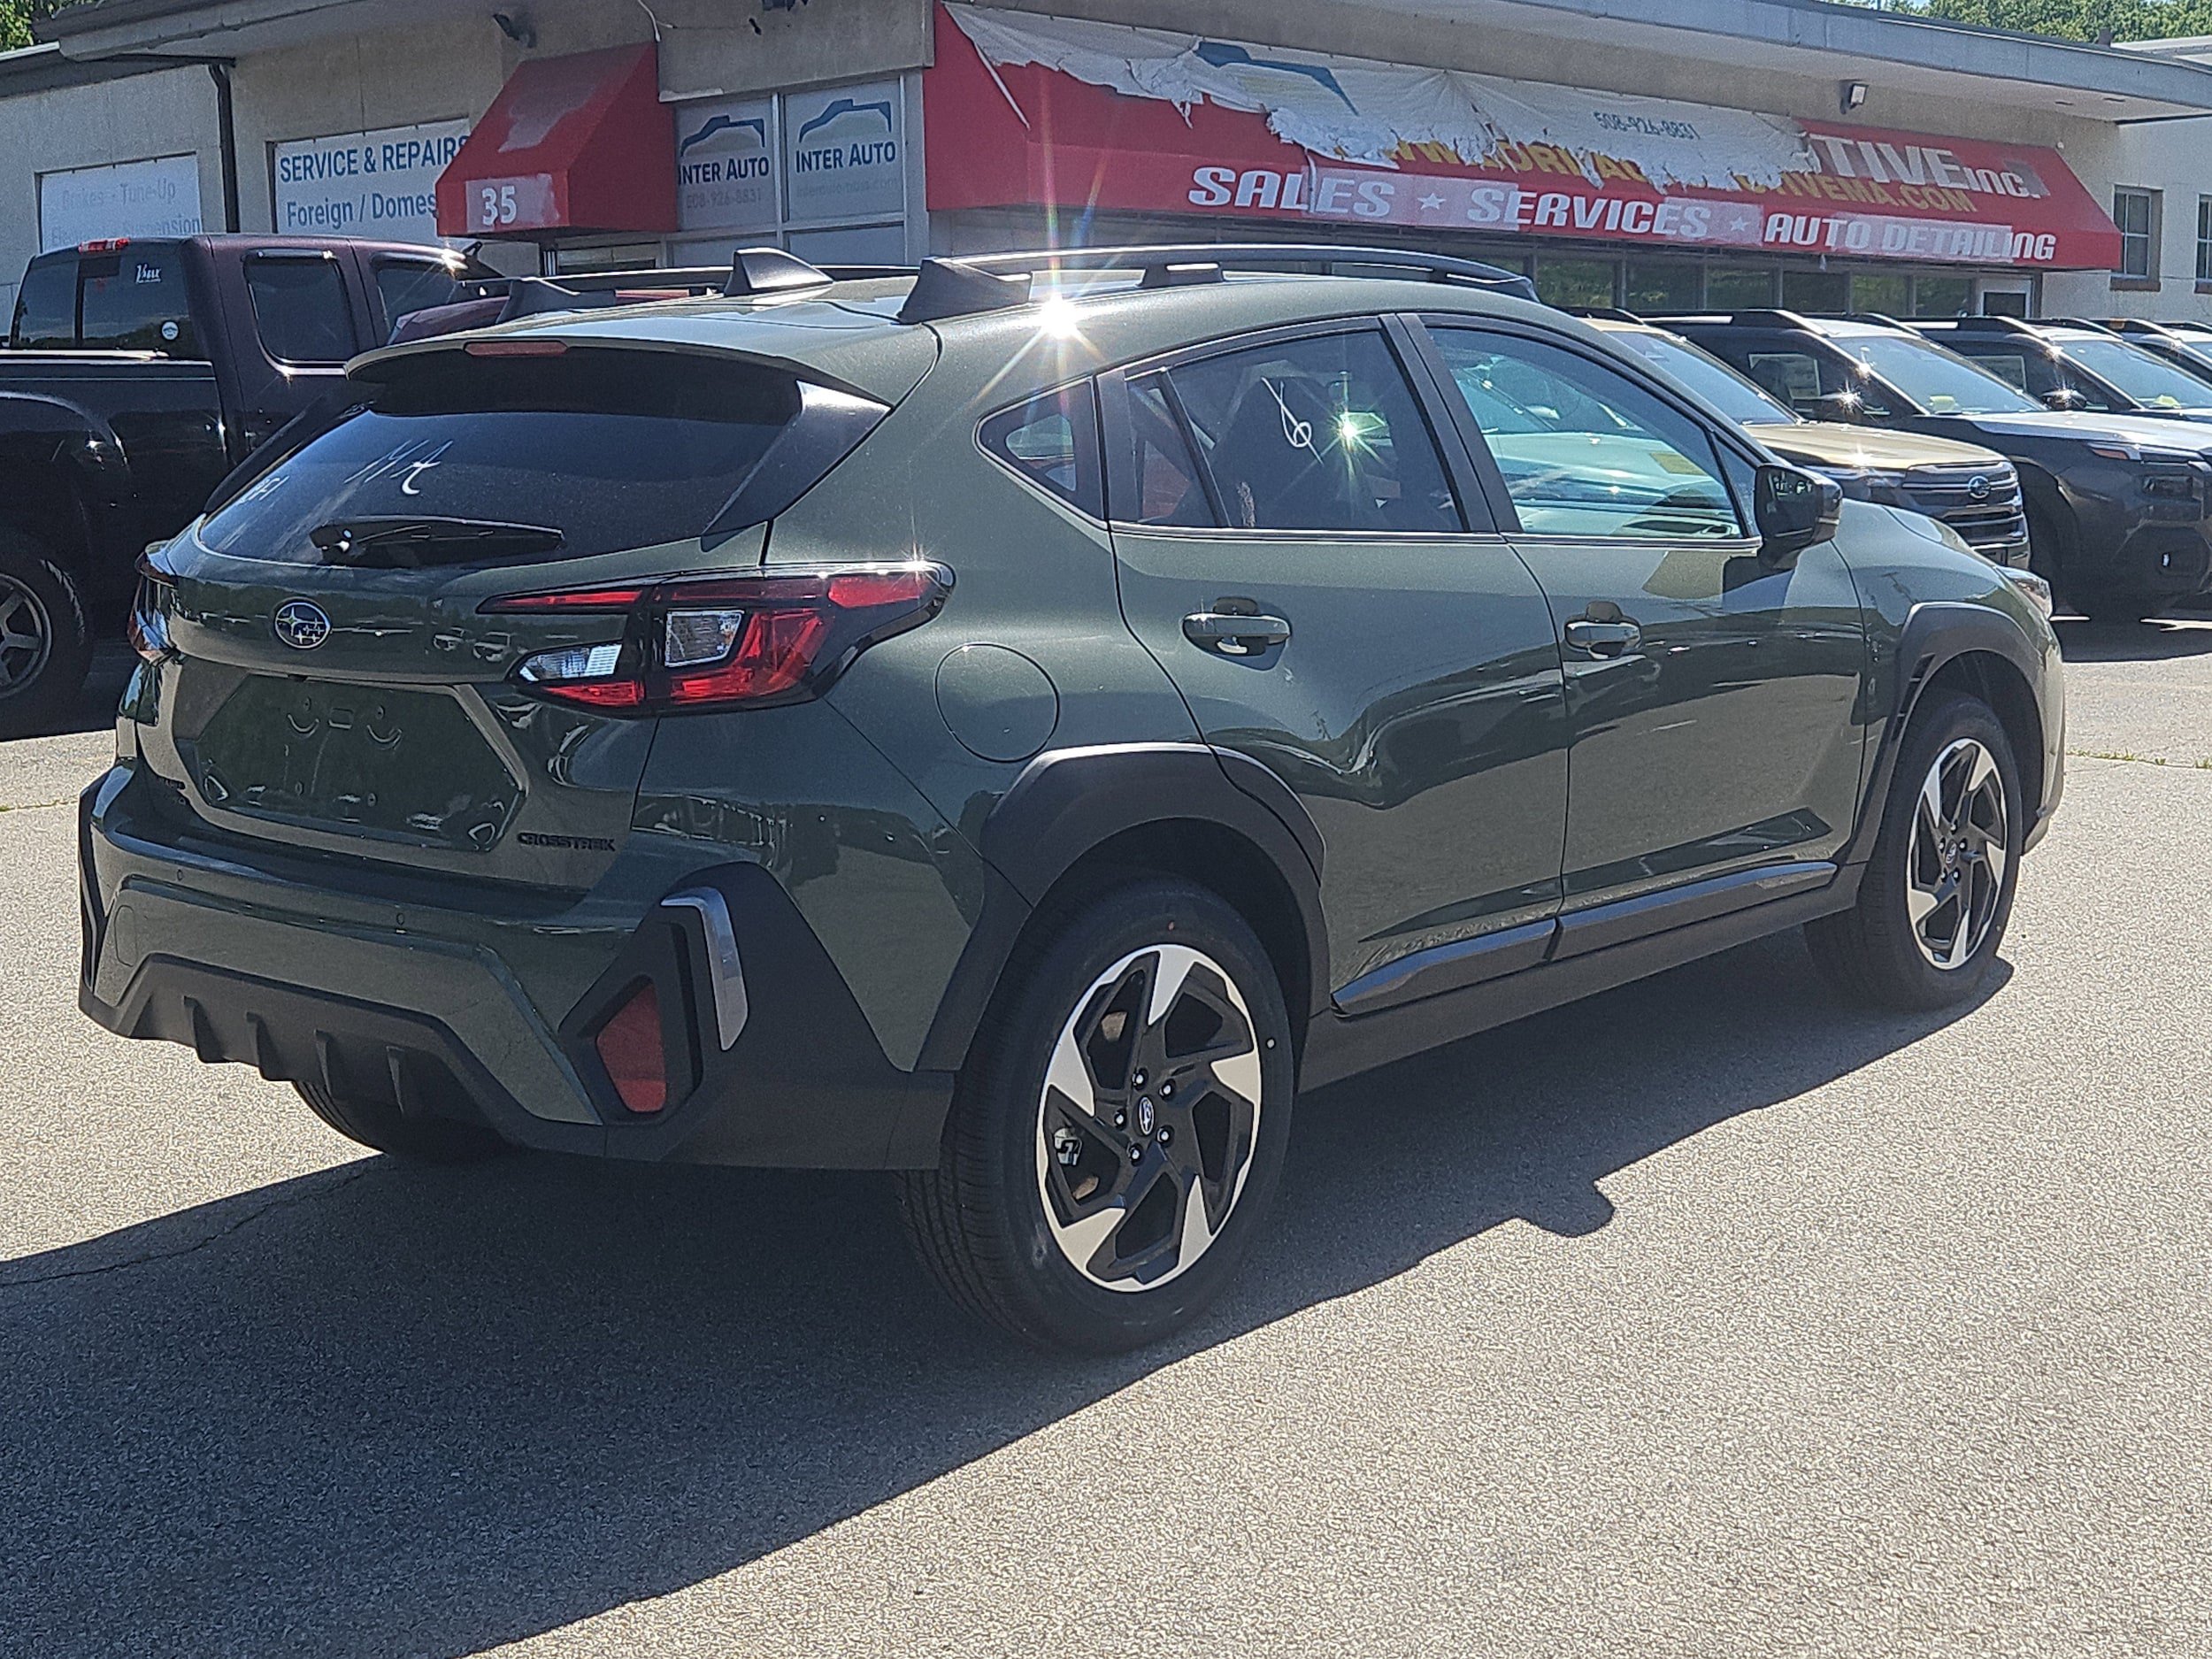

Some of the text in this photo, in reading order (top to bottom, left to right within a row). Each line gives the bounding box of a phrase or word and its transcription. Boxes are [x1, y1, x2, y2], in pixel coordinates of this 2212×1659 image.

[280, 149, 358, 183] SERVICE
[364, 146, 377, 173] &
[678, 157, 770, 186] INTER AUTO
[795, 142, 896, 173] INTER AUTO
[287, 196, 353, 229] Foreign
[358, 194, 366, 222] /
[481, 185, 517, 226] 35
[1187, 165, 2056, 260] SALES SERVICES AUTO DETAILING
[517, 832, 616, 851] CROSSTREK
